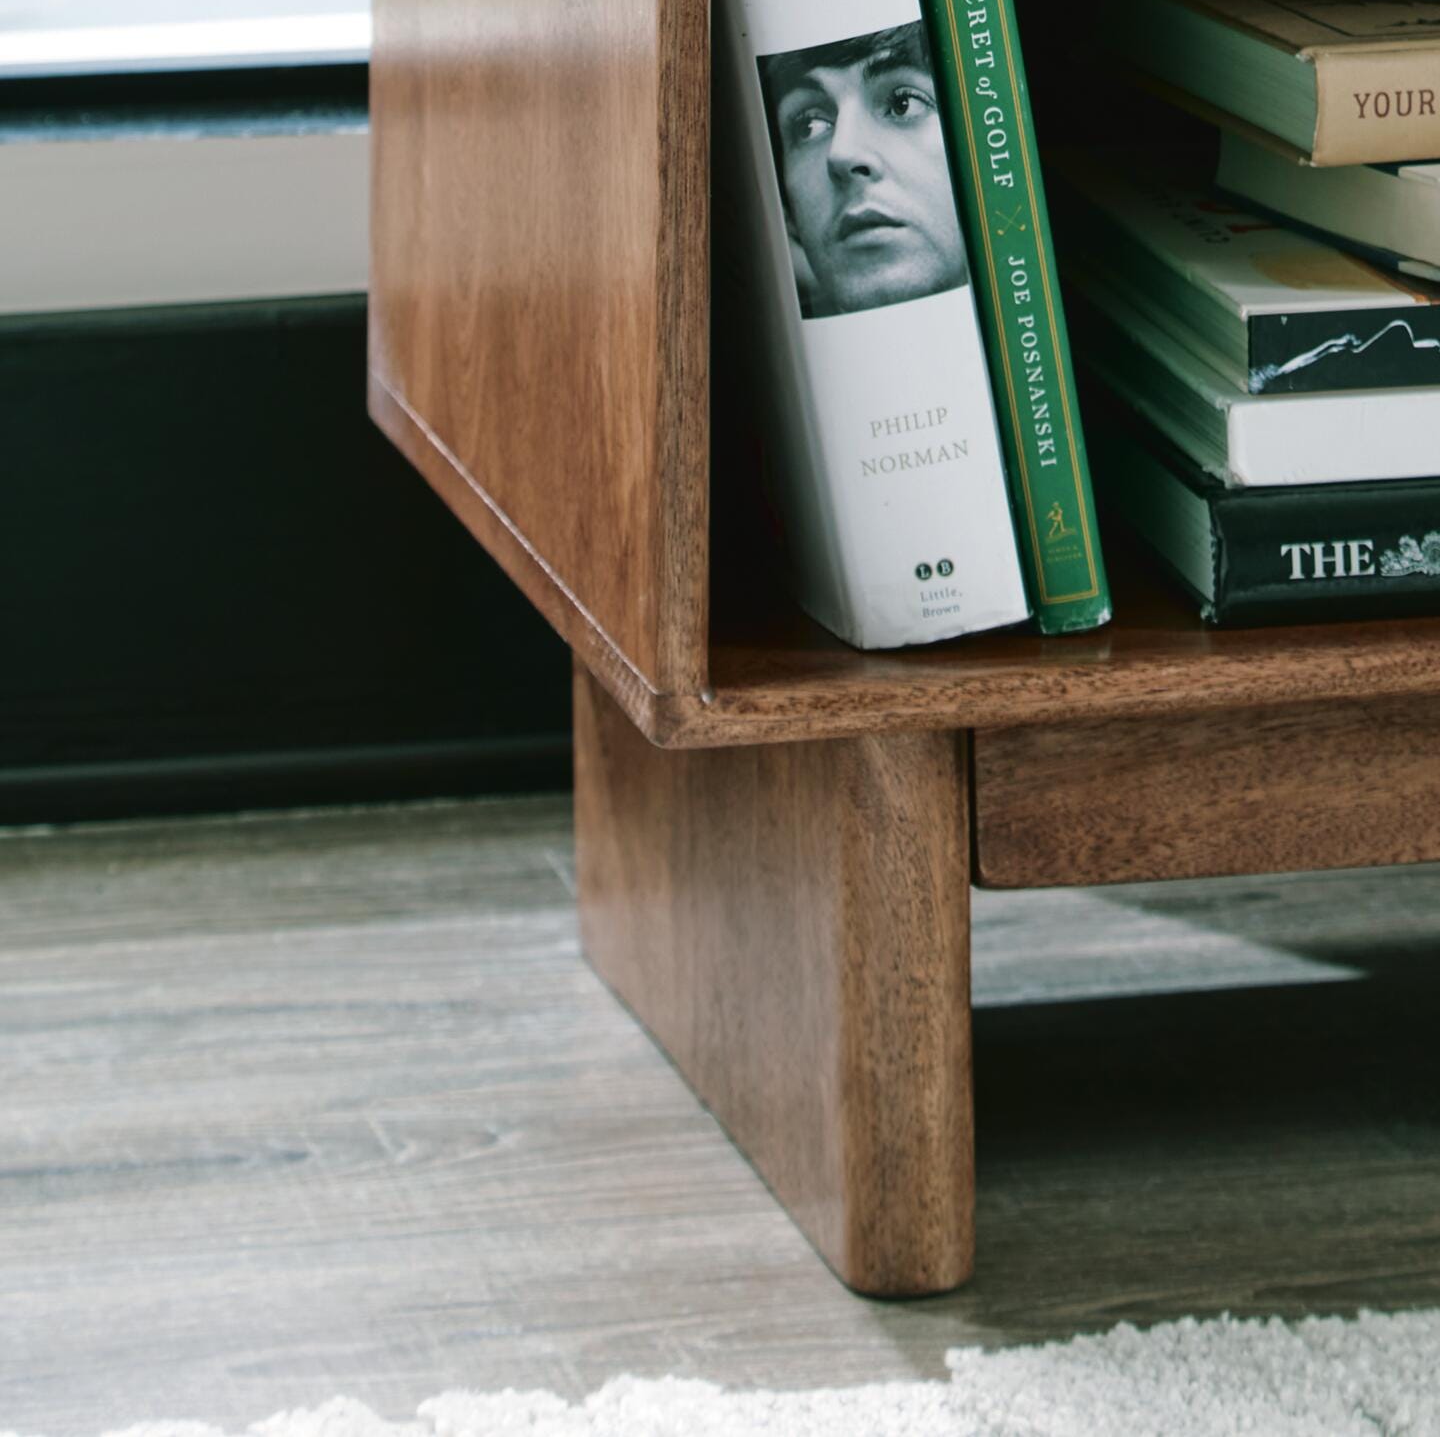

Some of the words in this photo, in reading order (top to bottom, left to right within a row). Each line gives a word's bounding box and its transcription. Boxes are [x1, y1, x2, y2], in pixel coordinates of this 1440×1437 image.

[975, 76, 998, 100] of
[1353, 89, 1436, 119] YOUR
[983, 105, 1014, 189] GOLF
[1008, 255, 1032, 305] JOE
[1018, 313, 1058, 468] POSNANSKI
[869, 406, 949, 439] PHILIP
[861, 439, 970, 477] NORMAN
[1280, 539, 1376, 580] THE
[922, 604, 961, 619] Brown
